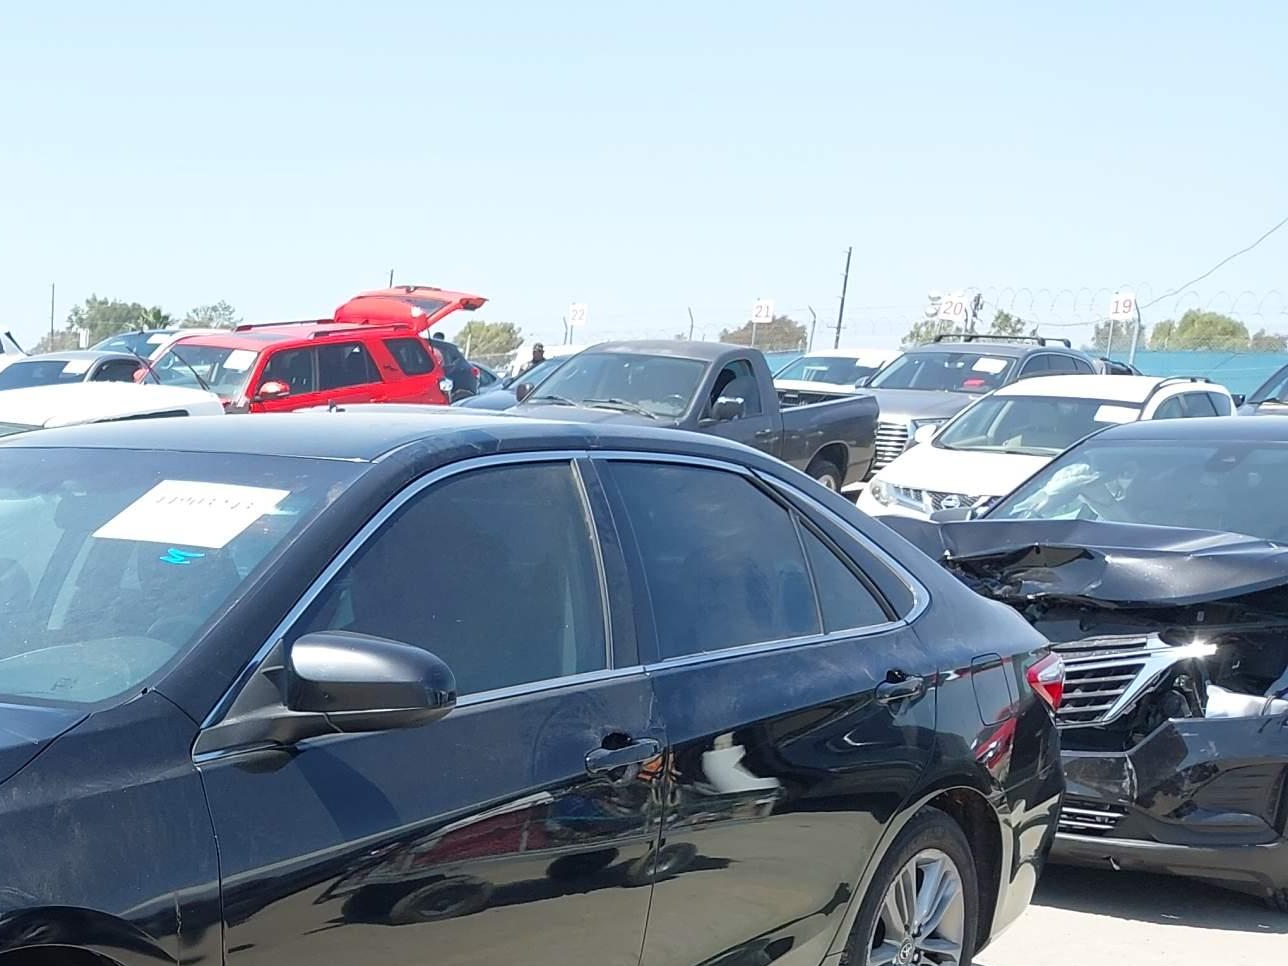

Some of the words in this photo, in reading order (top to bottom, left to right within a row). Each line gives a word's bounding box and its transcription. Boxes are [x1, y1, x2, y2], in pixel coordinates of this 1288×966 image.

[755, 305, 770, 318] 21
[943, 301, 963, 315] 20
[1112, 299, 1132, 315] 19
[571, 308, 585, 321] 22
